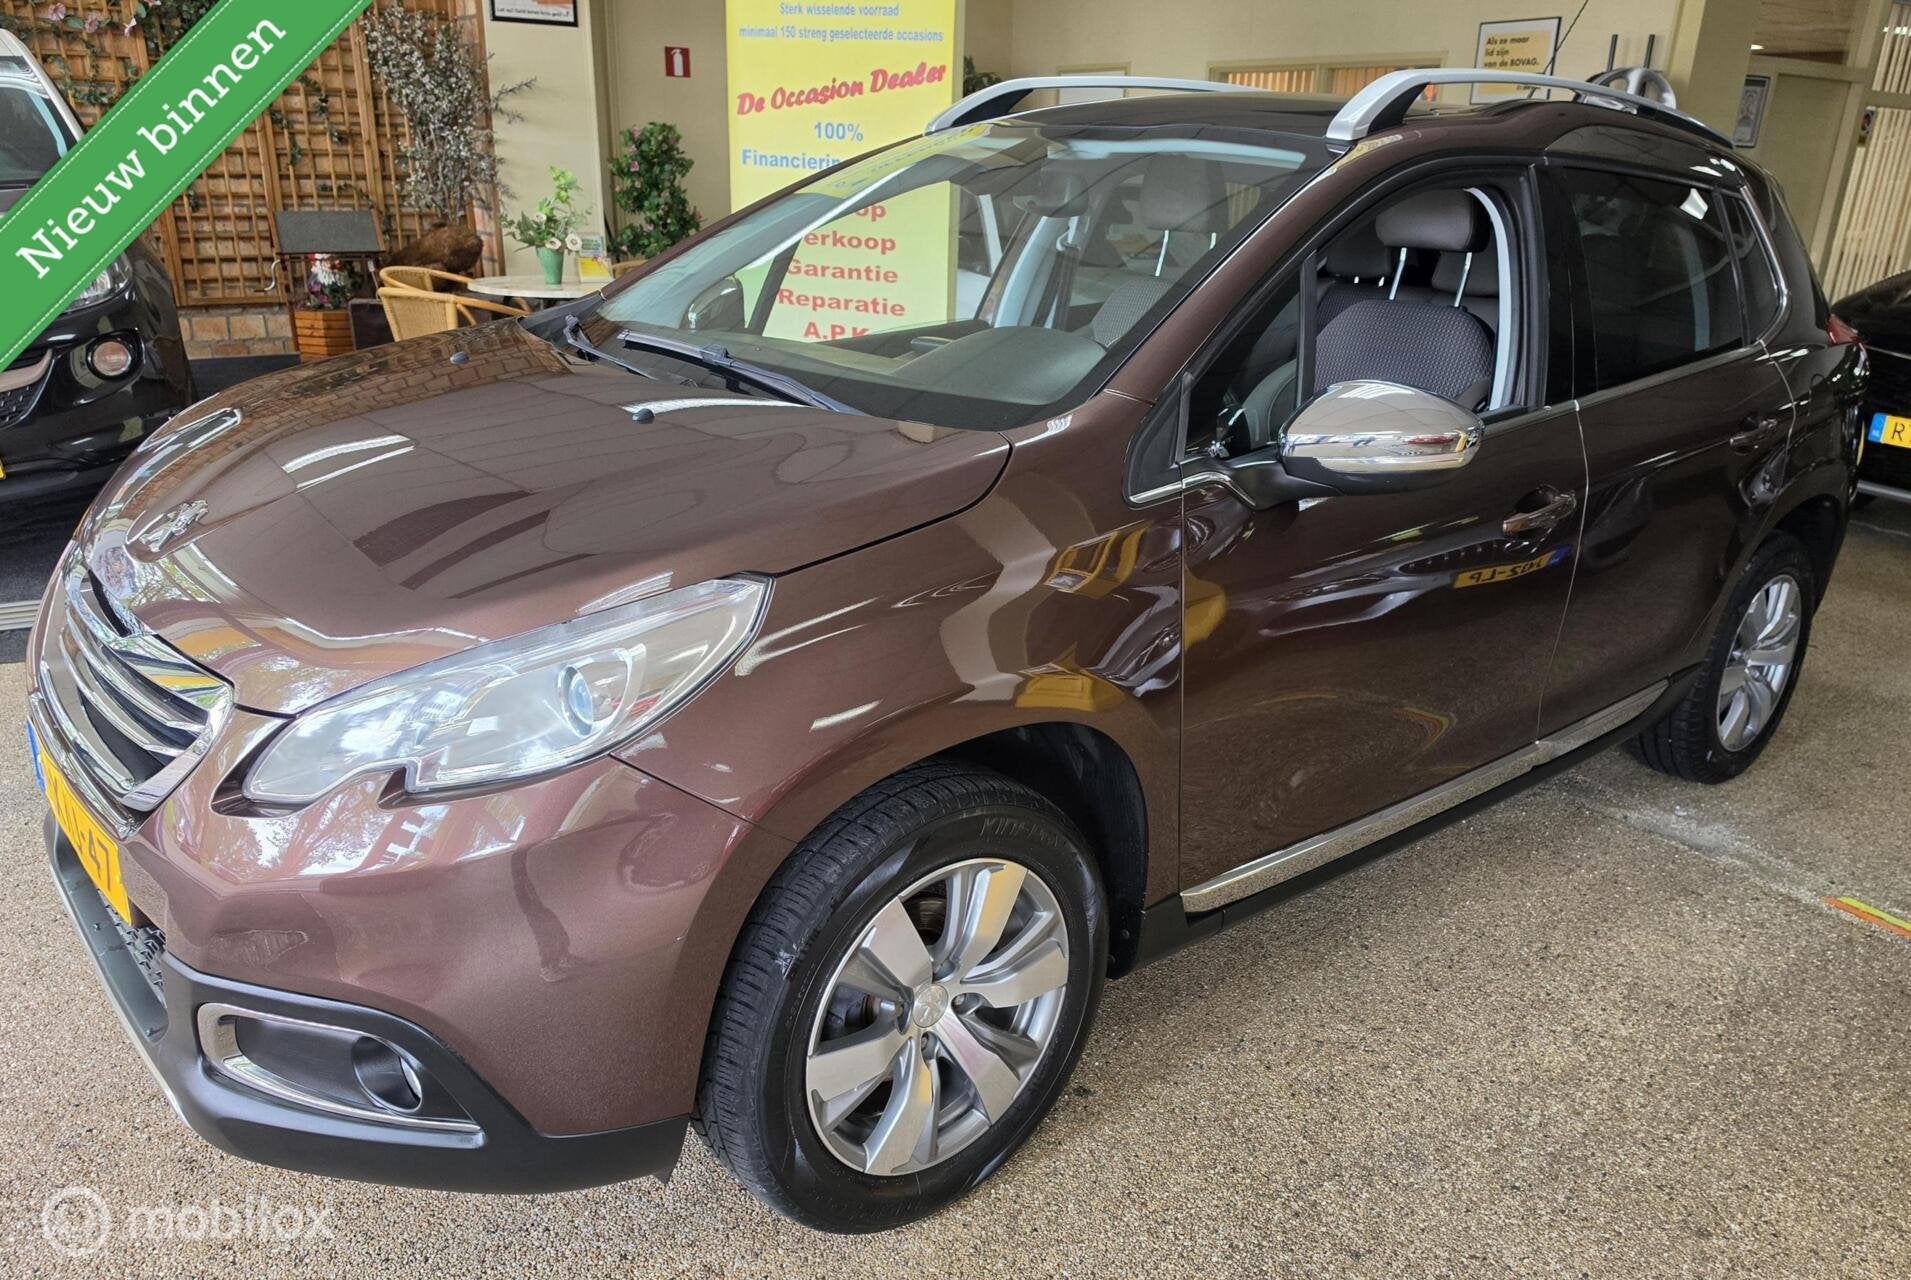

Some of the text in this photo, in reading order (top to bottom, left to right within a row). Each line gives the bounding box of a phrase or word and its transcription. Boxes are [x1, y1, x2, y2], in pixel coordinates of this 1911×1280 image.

[780, 3, 899, 16] Sterk wisselende voorraad
[739, 26, 943, 42] minimaal 150 streng geselecteerde occasions
[737, 62, 946, 115] De Occasion Dealer
[814, 122, 864, 142] 100%
[856, 205, 886, 222] op
[803, 230, 896, 254] erkoop
[787, 258, 898, 284] Garantie
[778, 288, 905, 316] Reparatie
